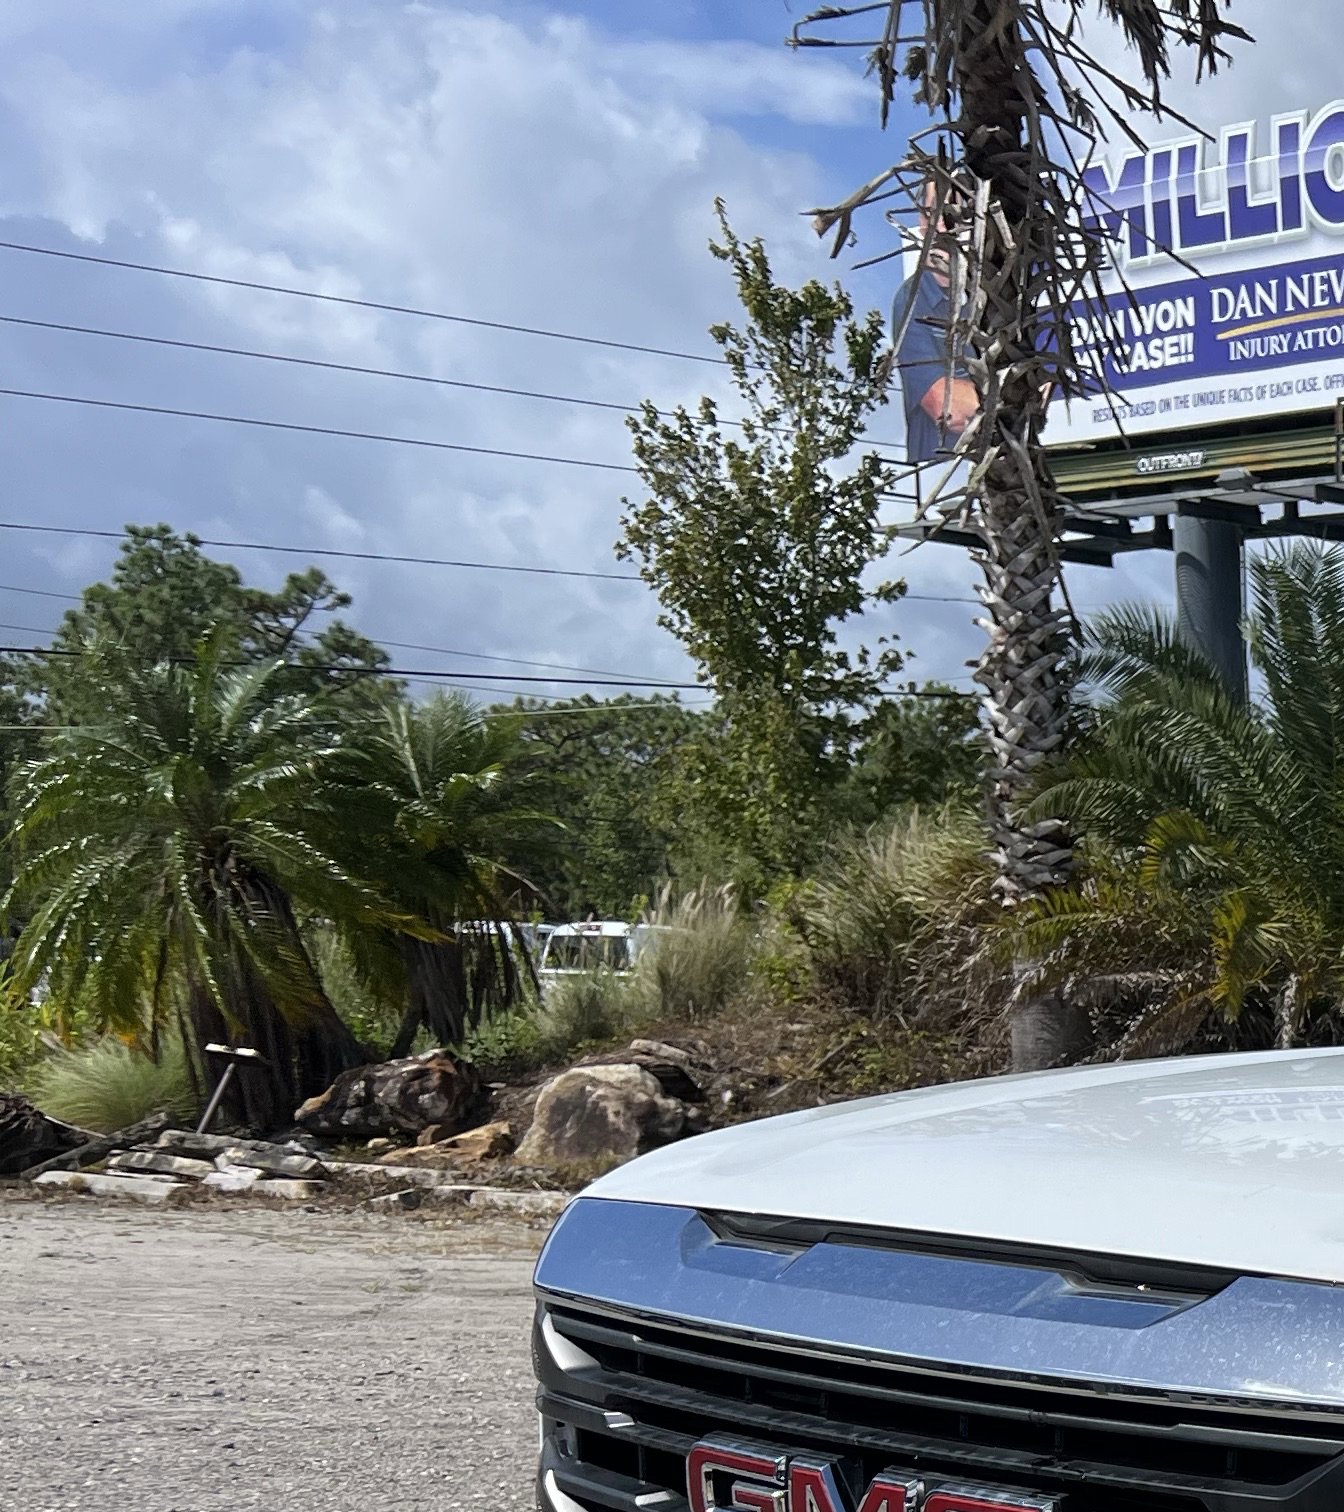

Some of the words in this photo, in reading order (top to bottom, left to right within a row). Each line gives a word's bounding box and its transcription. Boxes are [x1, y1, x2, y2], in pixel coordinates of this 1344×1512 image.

[1128, 296, 1196, 337] WON
[1209, 279, 1279, 323] DAN
[1228, 332, 1292, 361] INJURY
[1092, 405, 1127, 424] RESUTS
[1129, 400, 1157, 418] BASED
[1158, 397, 1172, 414] ON
[1174, 394, 1190, 410] THE
[1192, 388, 1226, 409] UNIQUE
[1228, 386, 1254, 403] FACTS
[1255, 384, 1268, 401] OF
[1270, 379, 1294, 399] EACH
